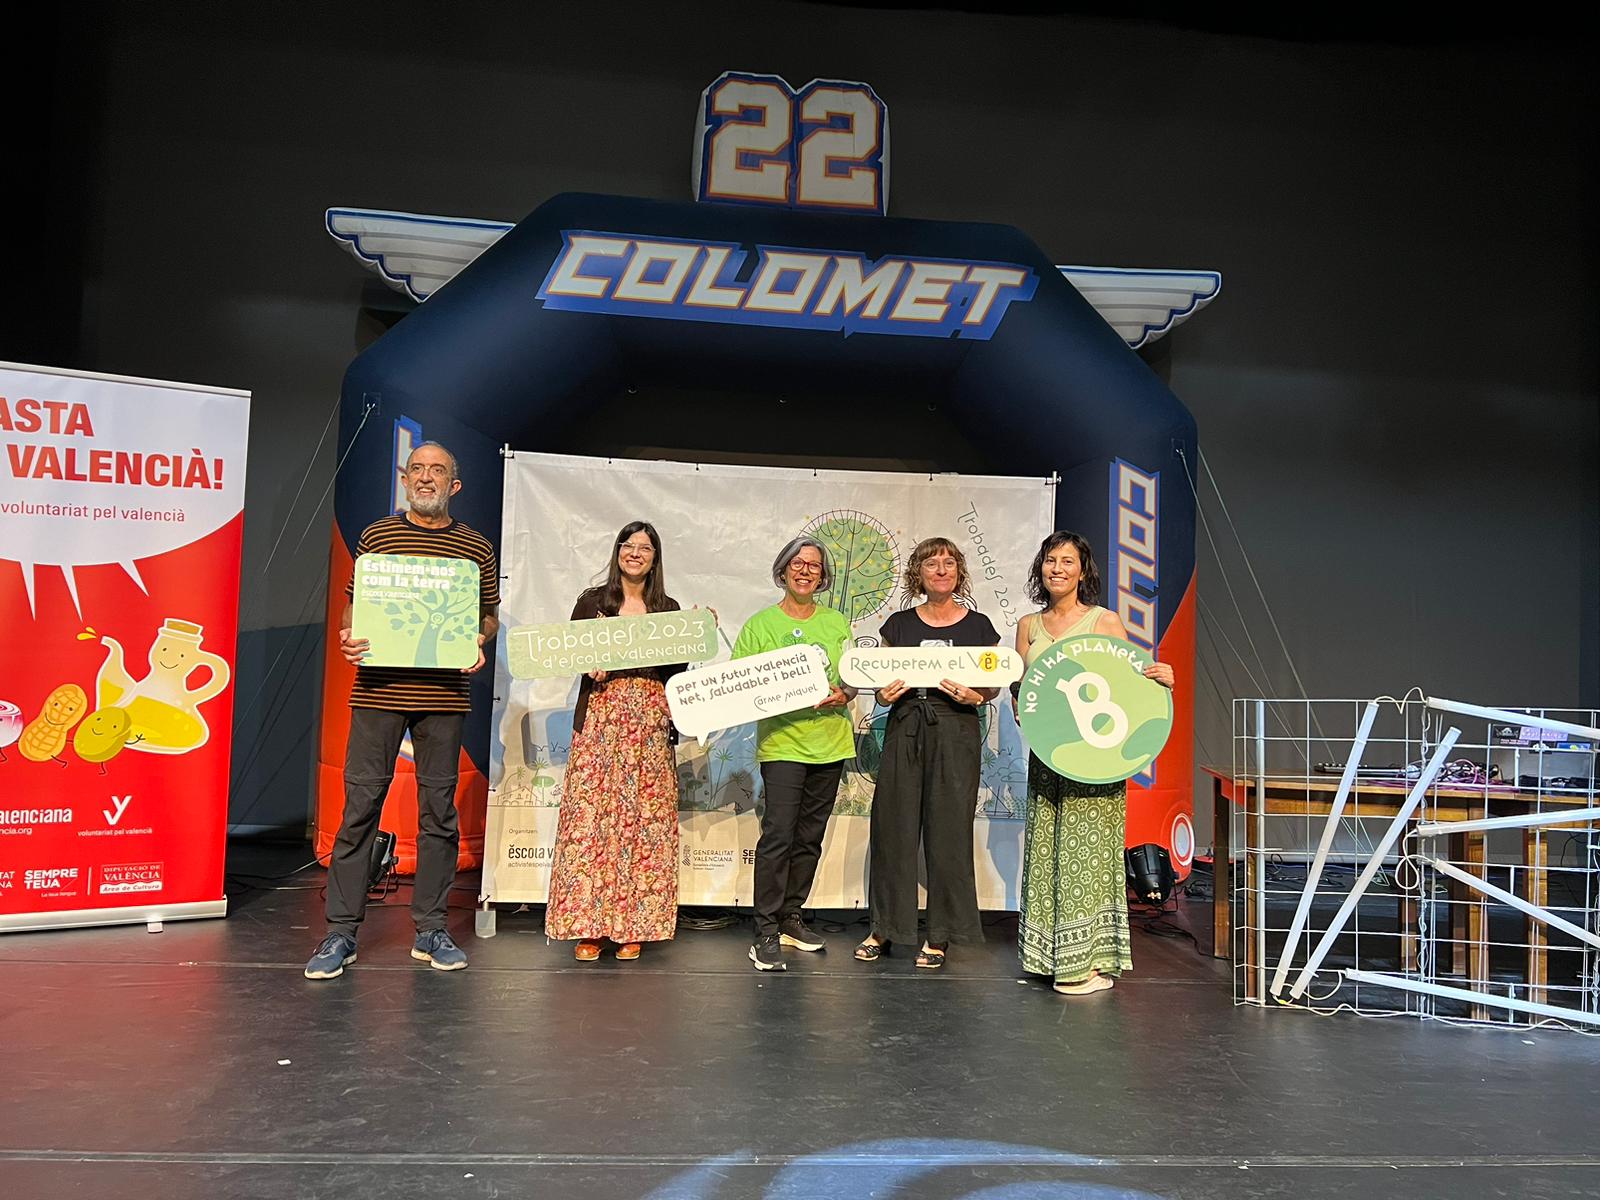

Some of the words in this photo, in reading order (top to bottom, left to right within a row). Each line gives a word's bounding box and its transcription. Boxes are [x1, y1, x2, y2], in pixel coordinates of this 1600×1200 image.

[706, 79, 880, 209] 22
[545, 235, 1027, 324] COLOMET
[6, 444, 223, 490] VALENCIÀ!
[1, 501, 88, 518] voluntariat
[93, 505, 116, 521] pel
[121, 506, 185, 522] valencià
[362, 575, 392, 586] com
[395, 575, 408, 588] la
[413, 575, 450, 590] terra
[994, 587, 1019, 628] 2023
[513, 623, 636, 662] Trobades
[647, 618, 705, 640] 2023
[542, 652, 611, 669] d'escola
[617, 642, 707, 661] valenciana
[675, 682, 697, 694] per
[721, 667, 751, 684] futur
[754, 652, 808, 673] valencià
[709, 676, 770, 700] saludable
[781, 664, 812, 681] bell!
[850, 657, 942, 682] Recuperem
[948, 658, 965, 670] el
[1024, 691, 1038, 713] NO
[1042, 651, 1068, 669] HA
[754, 695, 782, 712] Carme
[784, 683, 818, 702] Miquel
[24, 868, 78, 880] SEMPRE
[24, 879, 61, 890] TEUA
[104, 871, 160, 881] VALÈNCIA
